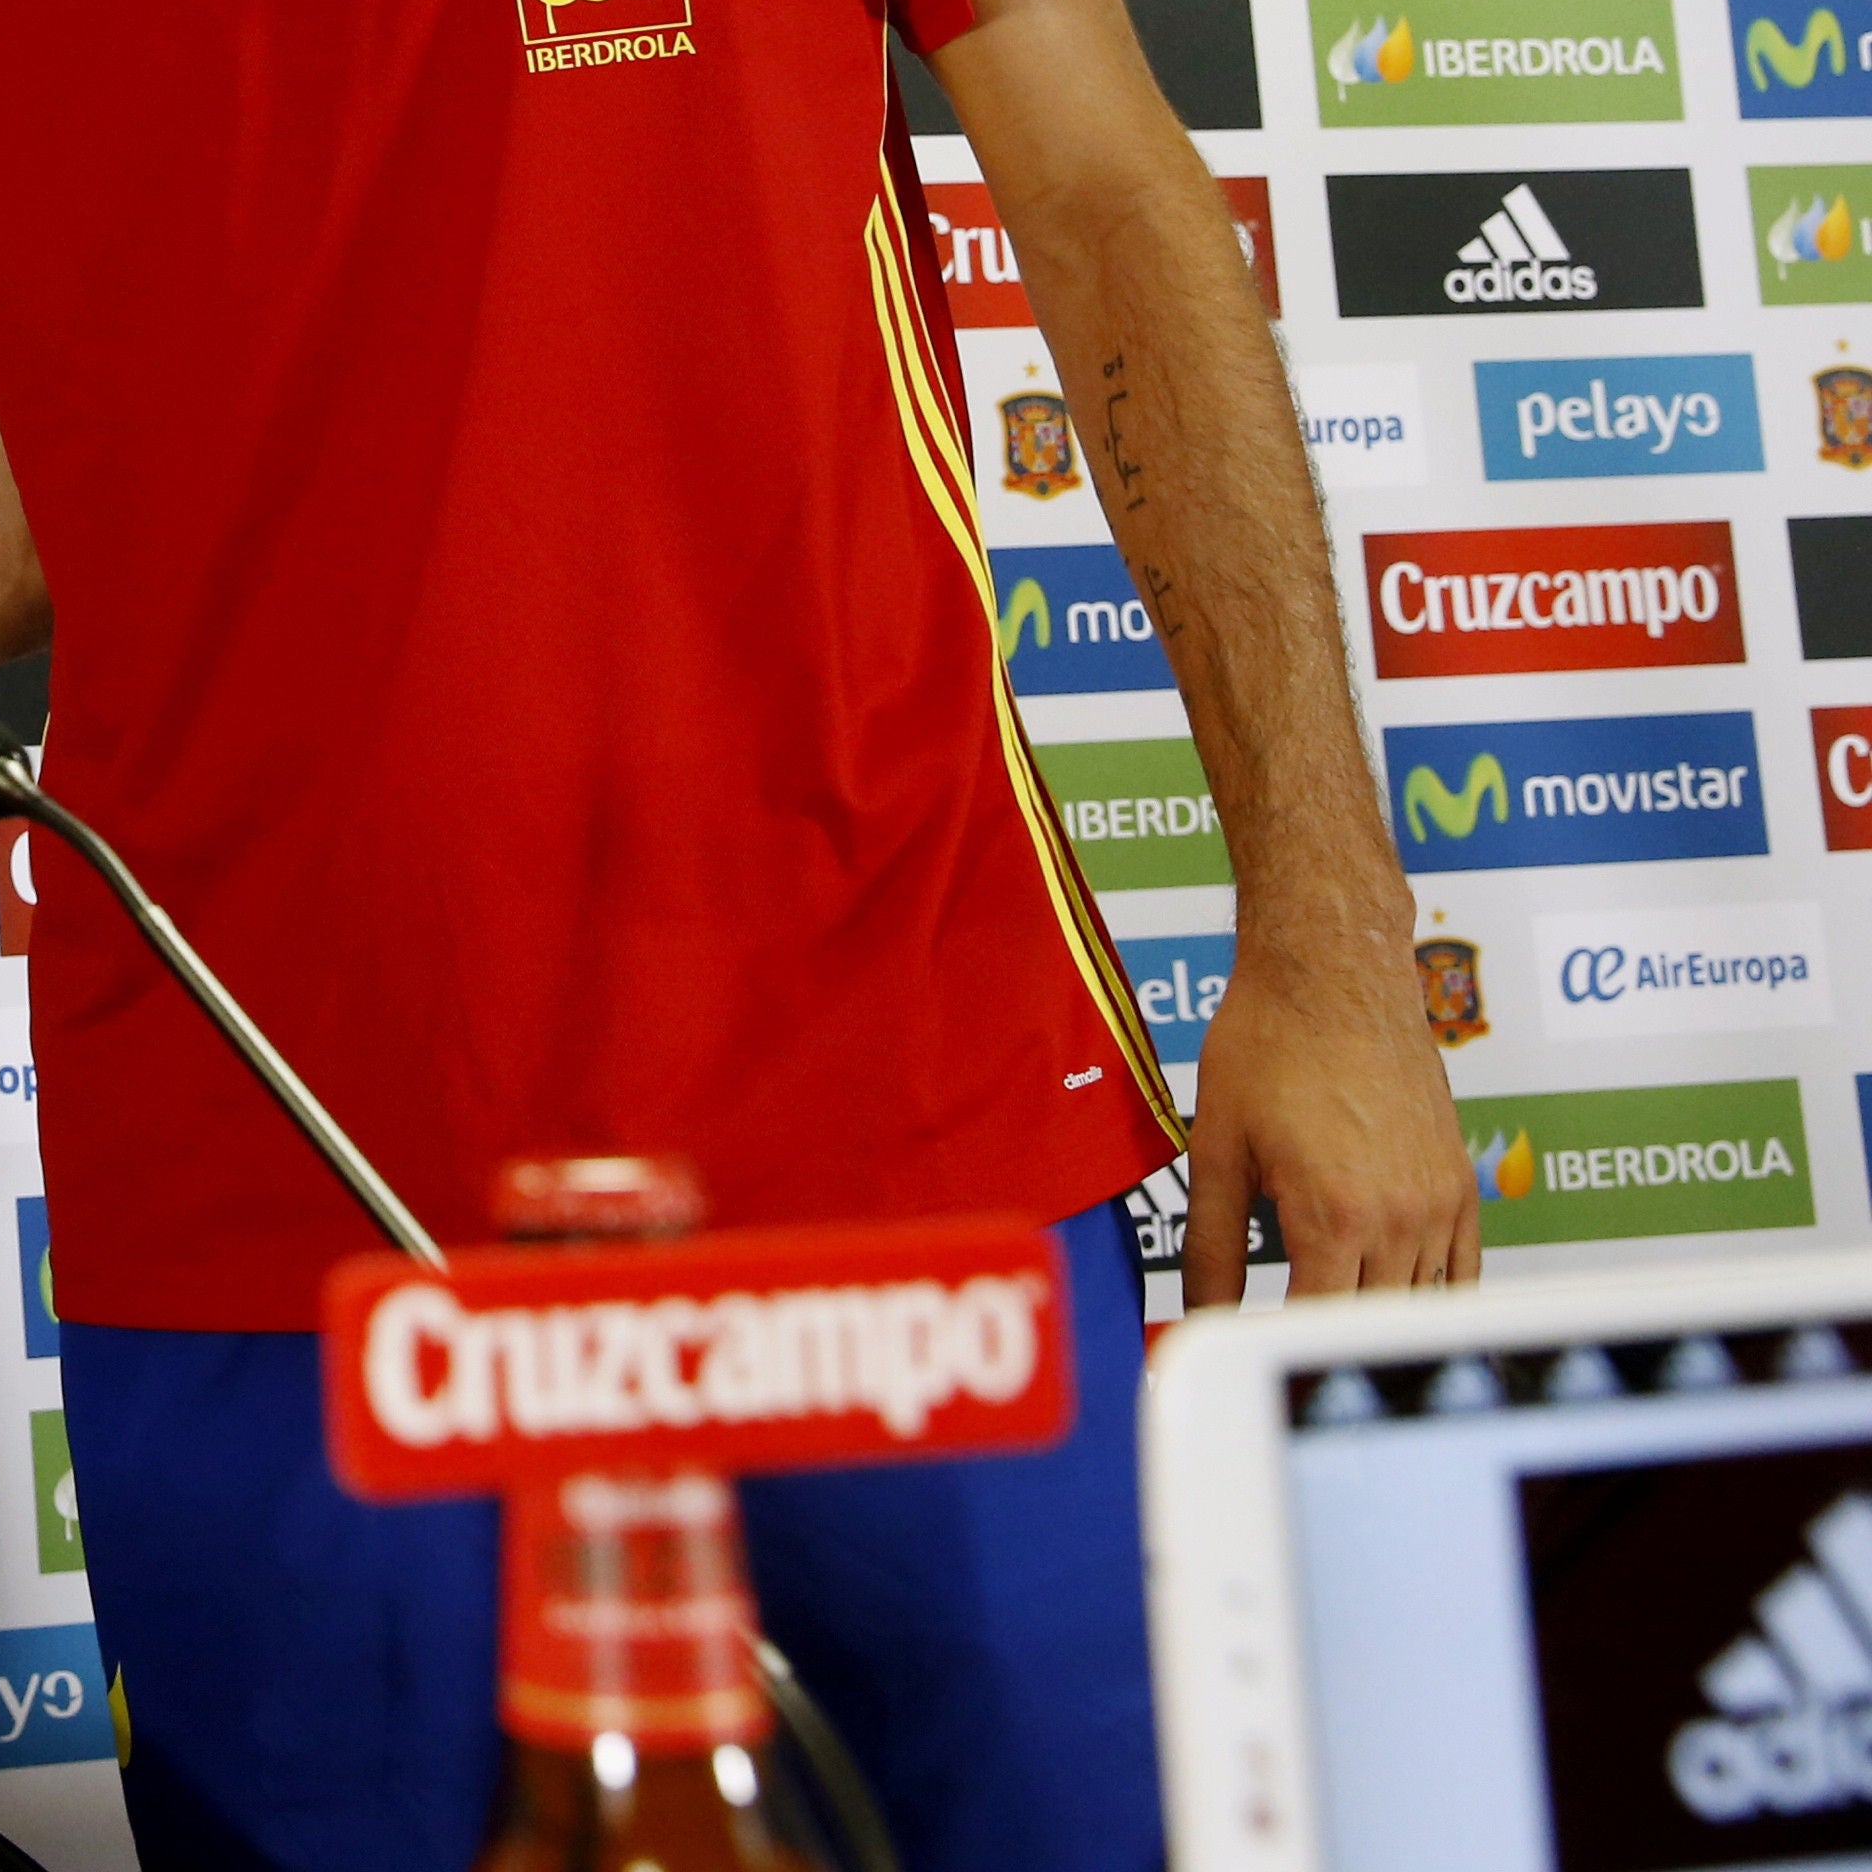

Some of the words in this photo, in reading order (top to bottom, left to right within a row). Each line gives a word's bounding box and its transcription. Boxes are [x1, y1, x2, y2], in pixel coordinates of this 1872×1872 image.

[526, 30, 696, 74] IBERDROLA
[1423, 36, 1663, 80] IBERDROLA
[1445, 260, 1597, 305] adidas
[1519, 378, 1720, 459] pelayo
[1380, 560, 1719, 639] Cruzcampo
[1524, 762, 1747, 817] movistar
[1635, 950, 1809, 994] AirEuropa
[1544, 1136, 1794, 1193] IBERDROLA
[363, 1275, 1038, 1447] Cruzcampo
